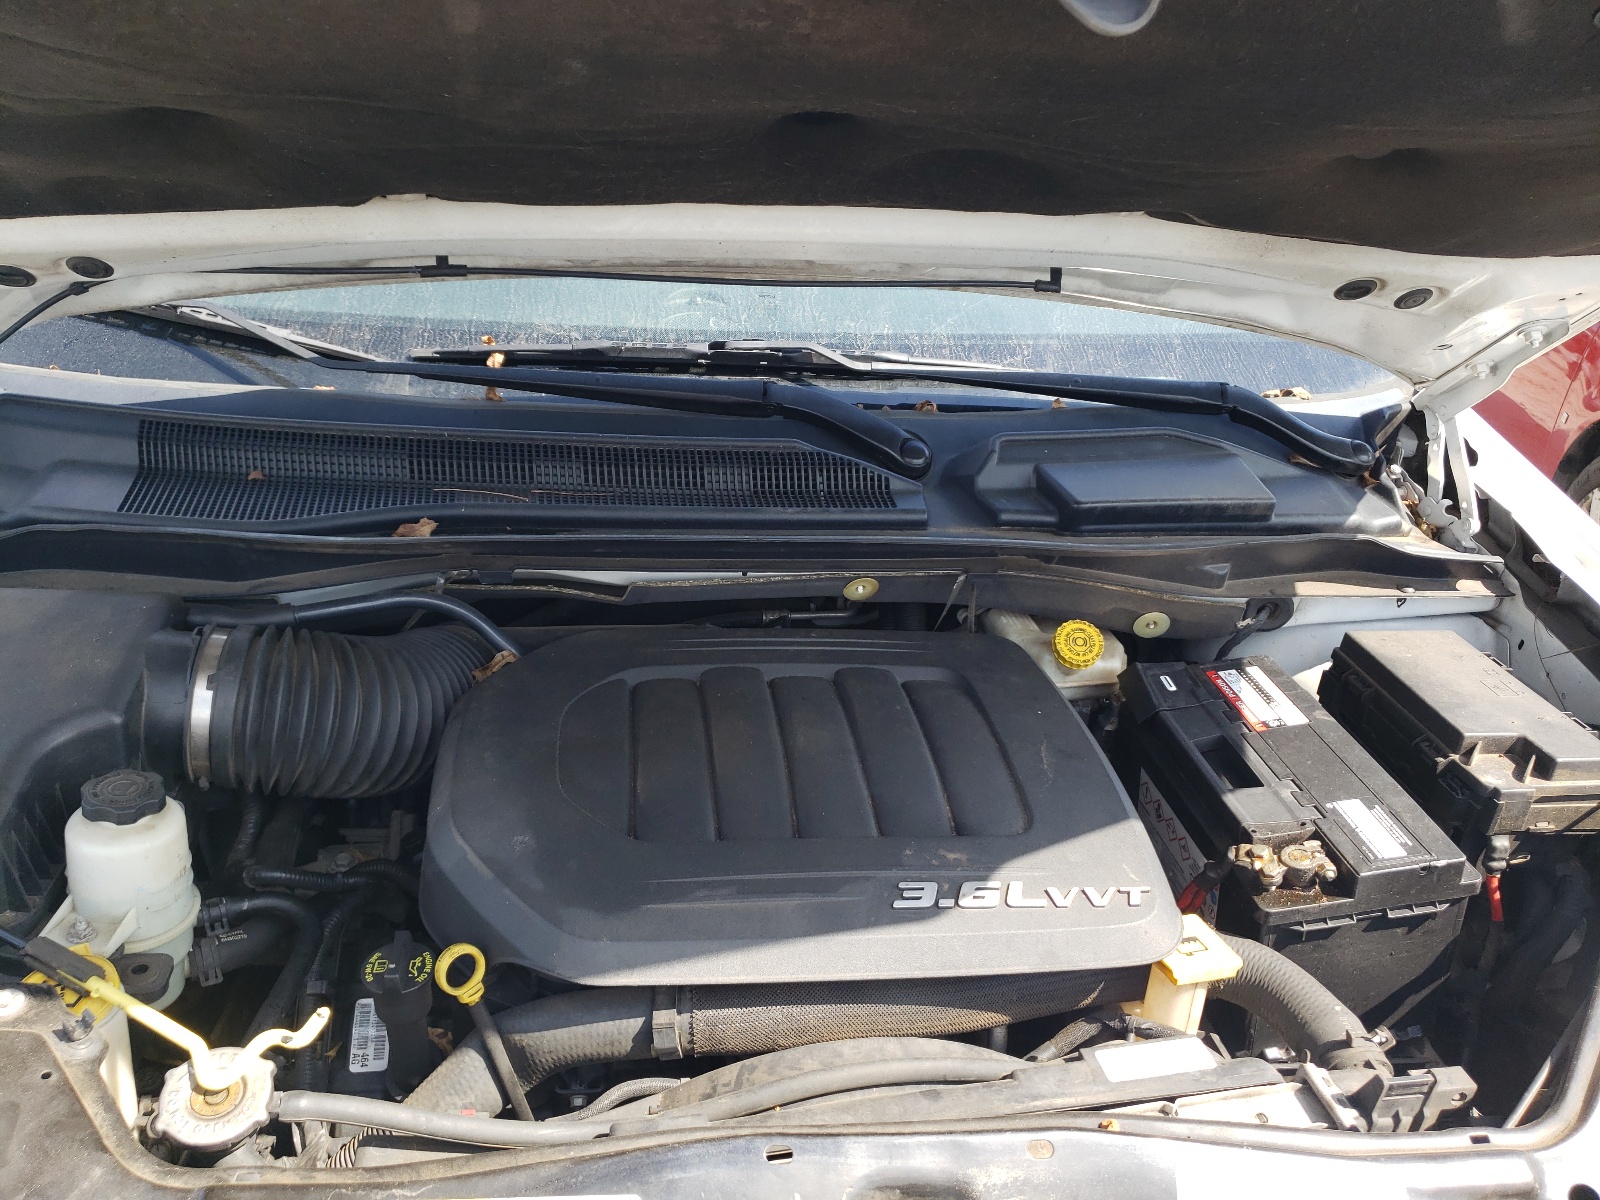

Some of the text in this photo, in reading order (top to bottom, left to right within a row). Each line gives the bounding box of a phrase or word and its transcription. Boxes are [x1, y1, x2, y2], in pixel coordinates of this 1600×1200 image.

[892, 881, 1151, 909] 3.6L VVT
[414, 951, 433, 983] ENGINE OIL
[351, 1053, 360, 1066] AG
[360, 1052, 370, 1068] 464
